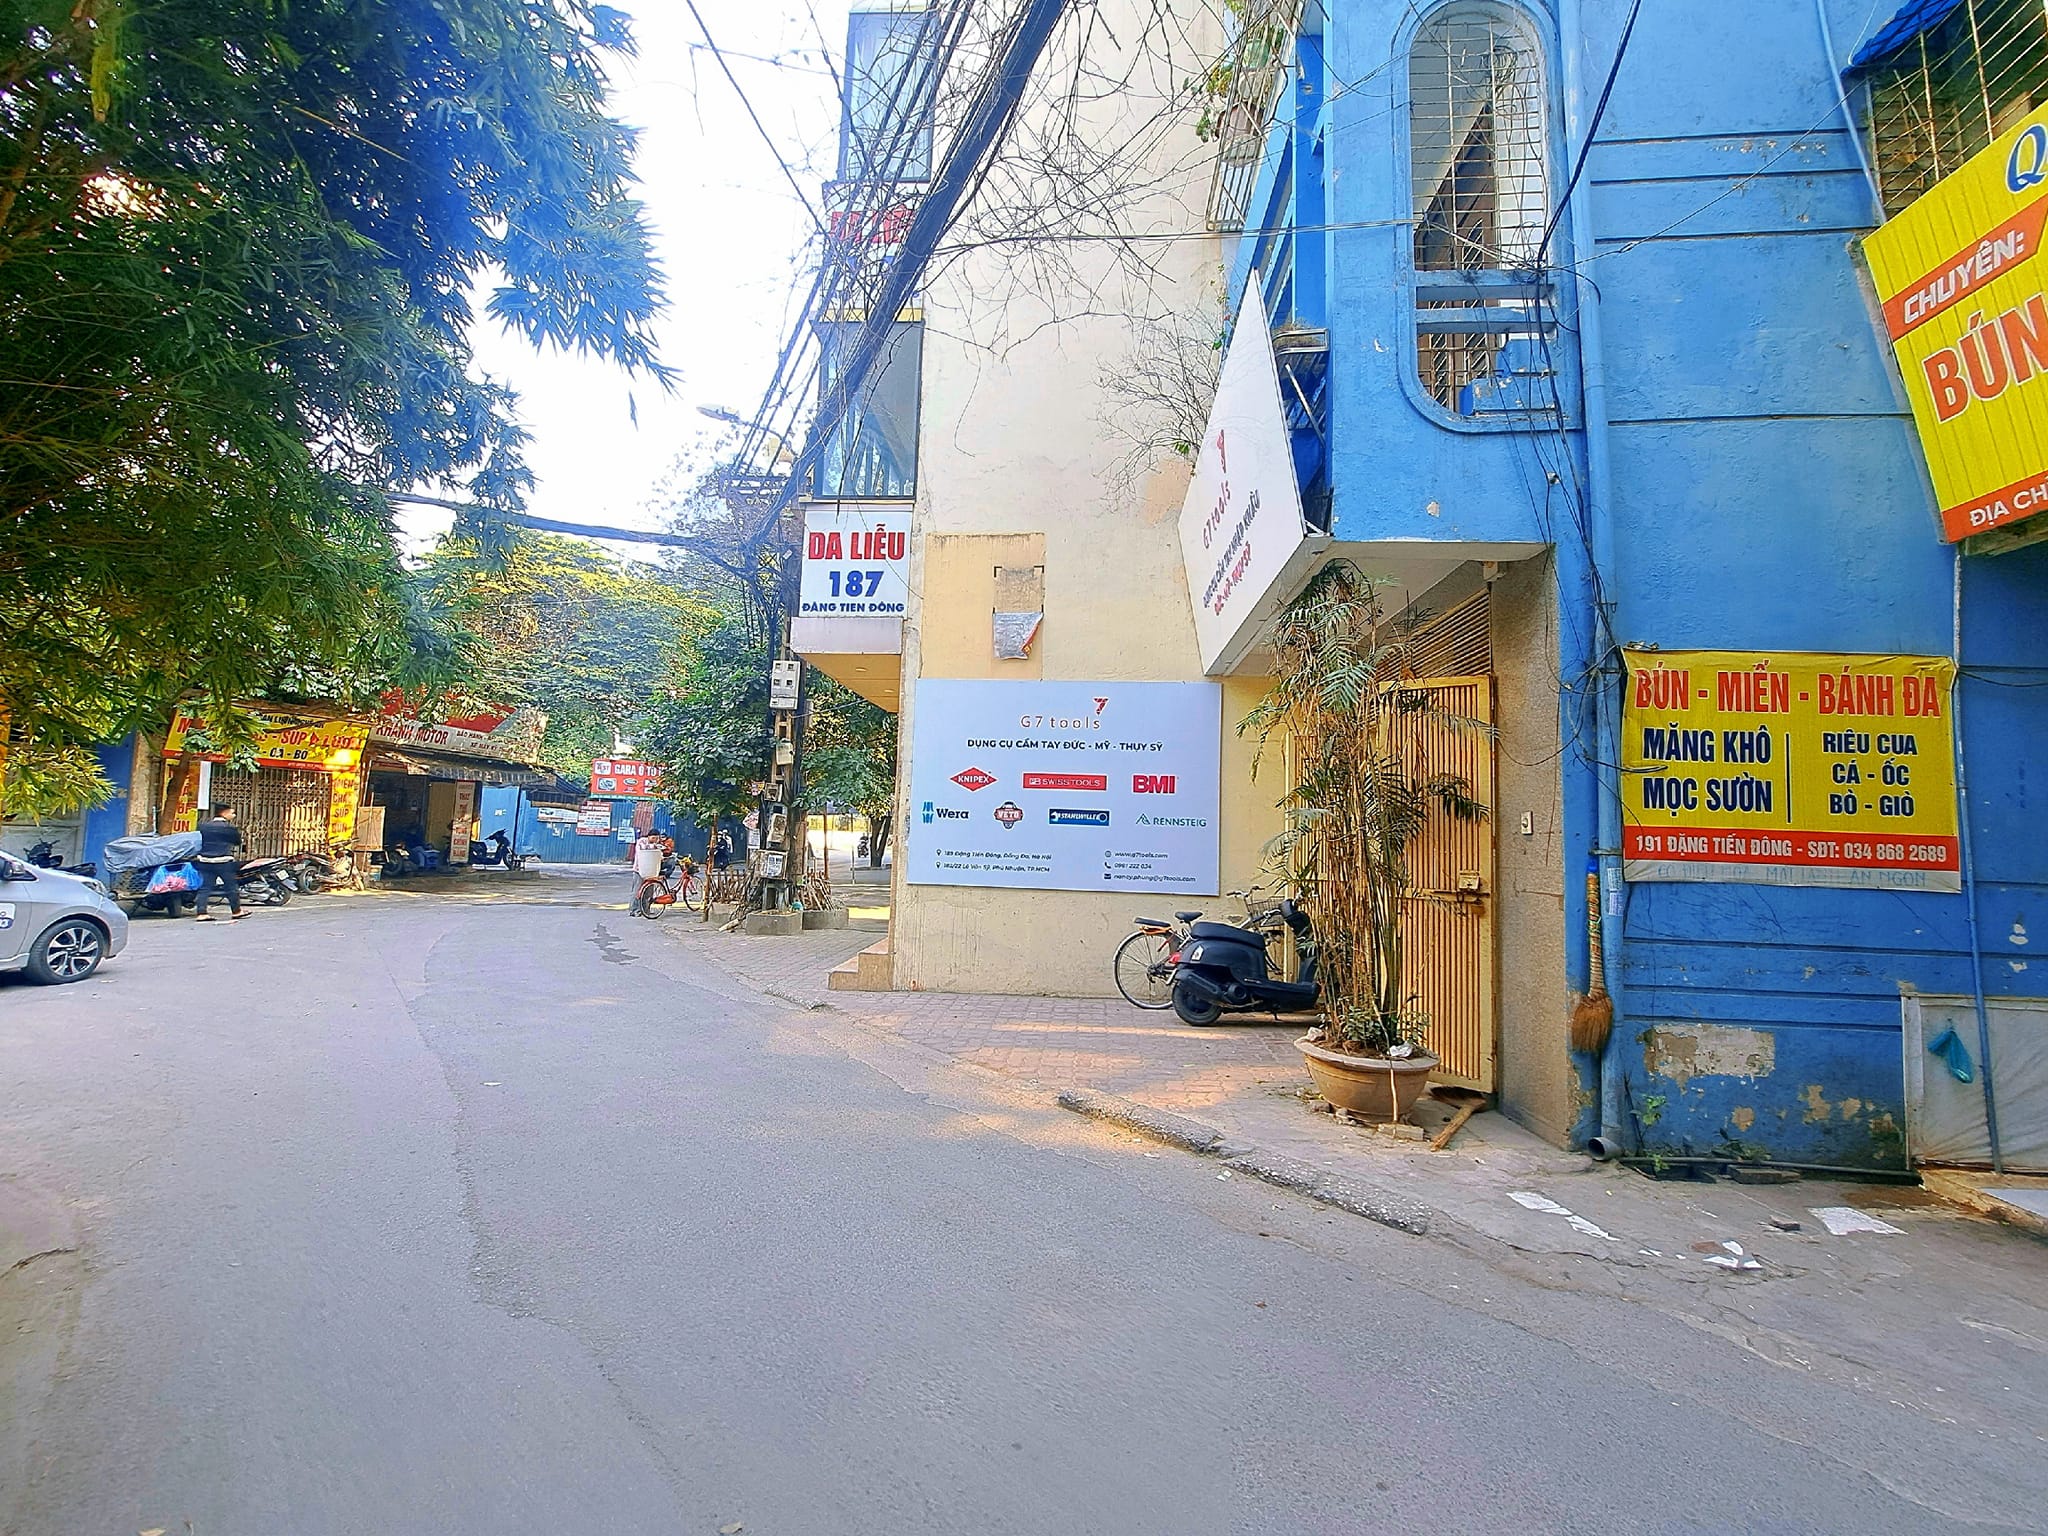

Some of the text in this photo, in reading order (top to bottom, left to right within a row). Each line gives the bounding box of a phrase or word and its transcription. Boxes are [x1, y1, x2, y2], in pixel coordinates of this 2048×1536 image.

[2005, 124, 2048, 194] Q
[1904, 229, 2025, 324] CHUYÊN:
[1921, 292, 2048, 424] BÚN
[1969, 476, 2048, 527] ĐỊA CH
[808, 523, 905, 561] DA LIỄU
[829, 571, 885, 597] 187
[1635, 661, 1690, 710] BÚN
[1717, 660, 1790, 714] MIẾN
[1818, 666, 1895, 717] BÁNH
[1902, 674, 1942, 718] ĐA
[415, 727, 449, 745] MOTOR
[1021, 716, 1101, 730] G7 tools
[967, 739, 996, 749] DỤNG
[1000, 740, 1013, 750] CỤ
[1016, 738, 1038, 749] CẦM
[1041, 741, 1060, 749] TAY
[1063, 739, 1086, 750] ĐỨC
[1095, 740, 1110, 751] MỸ
[1120, 742, 1147, 752] THỤY
[1150, 741, 1163, 752] SỸ
[1643, 722, 1772, 764] MĂNG KHÔ
[1822, 729, 1918, 756] RIÊU CUA
[614, 764, 637, 776] GARA
[958, 775, 990, 784] KNIPEX
[1832, 761, 1861, 785] CÁ
[1881, 757, 1910, 786] ỐC
[1133, 775, 1175, 794] BMI
[1643, 771, 1773, 817] MỌC SƯỜN
[936, 808, 969, 819] Wera
[1829, 790, 1857, 815] BÒ
[1879, 790, 1915, 817] GIÒ
[1153, 817, 1207, 827] RENNSTEIG
[1636, 835, 1661, 853] 191
[1667, 836, 1708, 857] ĐẶNG
[1713, 833, 1746, 855] TIẾN
[1750, 836, 1792, 857] ĐÔNG
[1807, 841, 1840, 859] SĐT:
[1844, 842, 1872, 860] 034
[1876, 843, 1904, 860] 868
[1909, 844, 1947, 862] 2689
